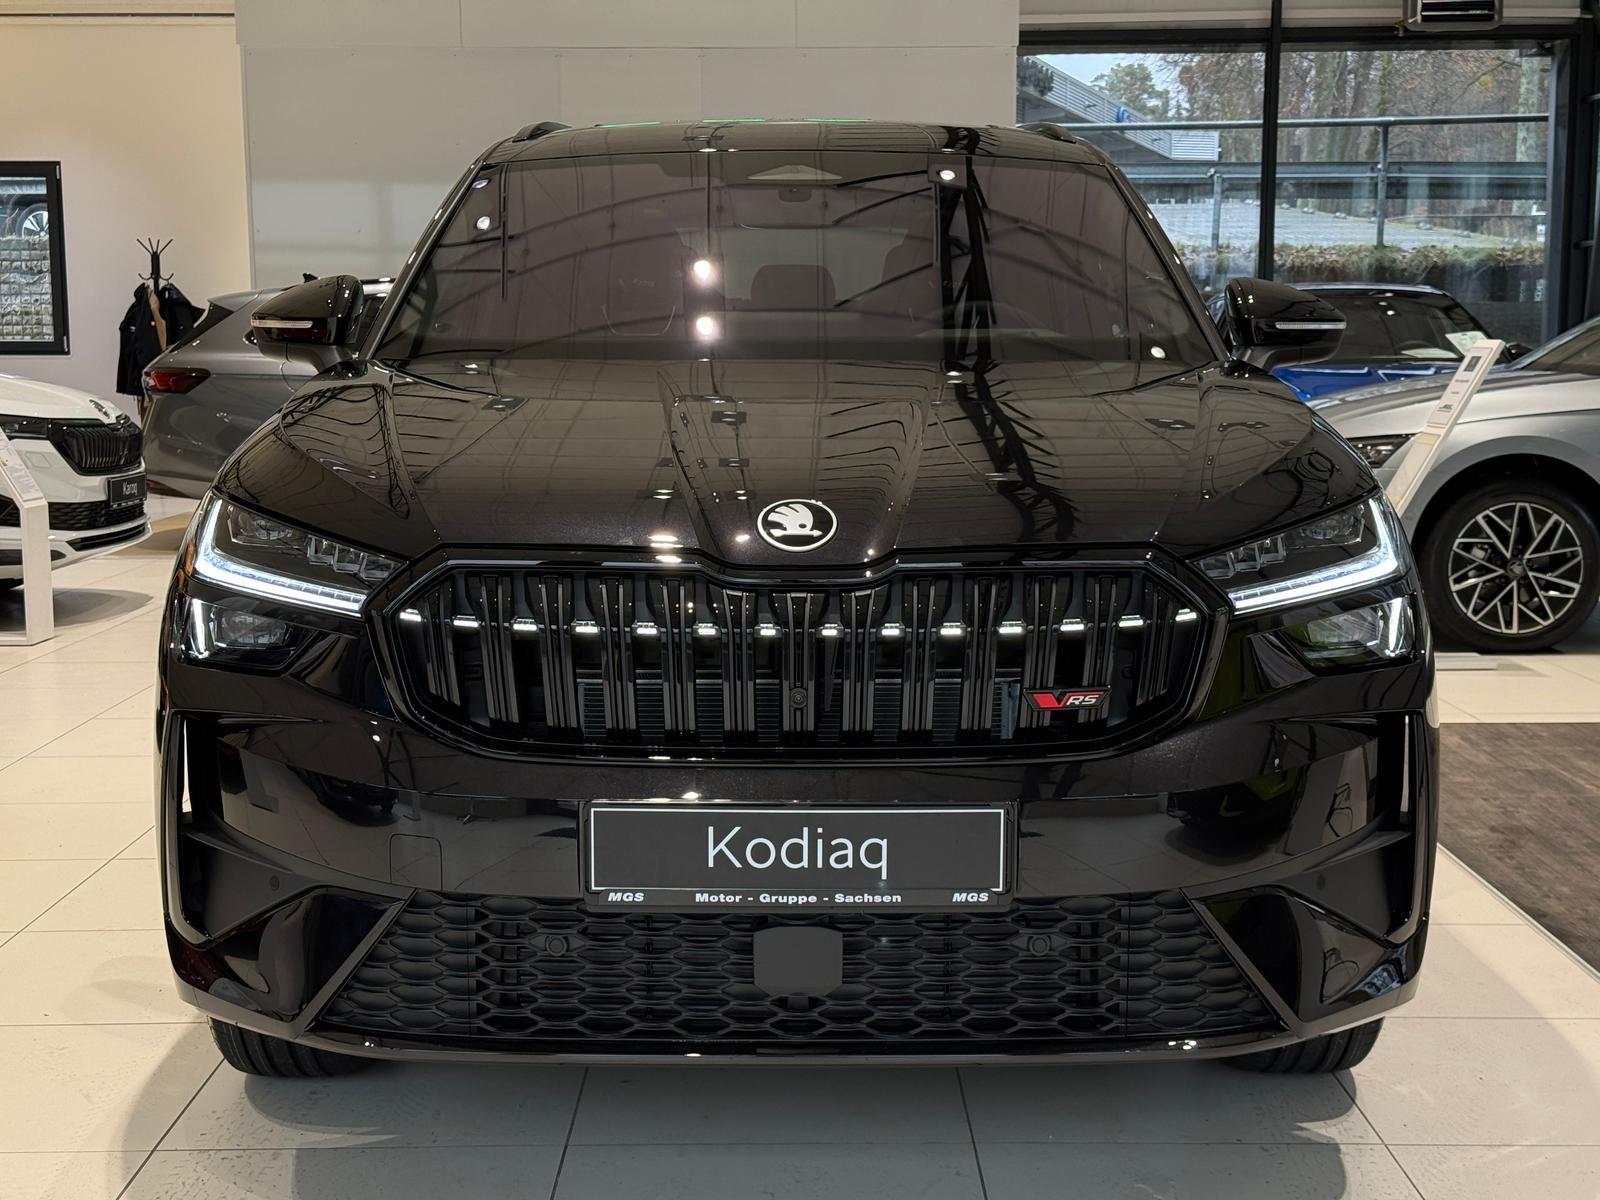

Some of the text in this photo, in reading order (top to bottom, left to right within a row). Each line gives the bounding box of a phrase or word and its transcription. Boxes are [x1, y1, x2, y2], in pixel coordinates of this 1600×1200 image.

[707, 826, 888, 880] Kodiaq
[608, 892, 645, 903] MGS
[696, 892, 743, 903] Motor
[759, 892, 818, 905] Gruppe
[834, 892, 903, 903] Sachsen
[952, 892, 990, 903] MGS
